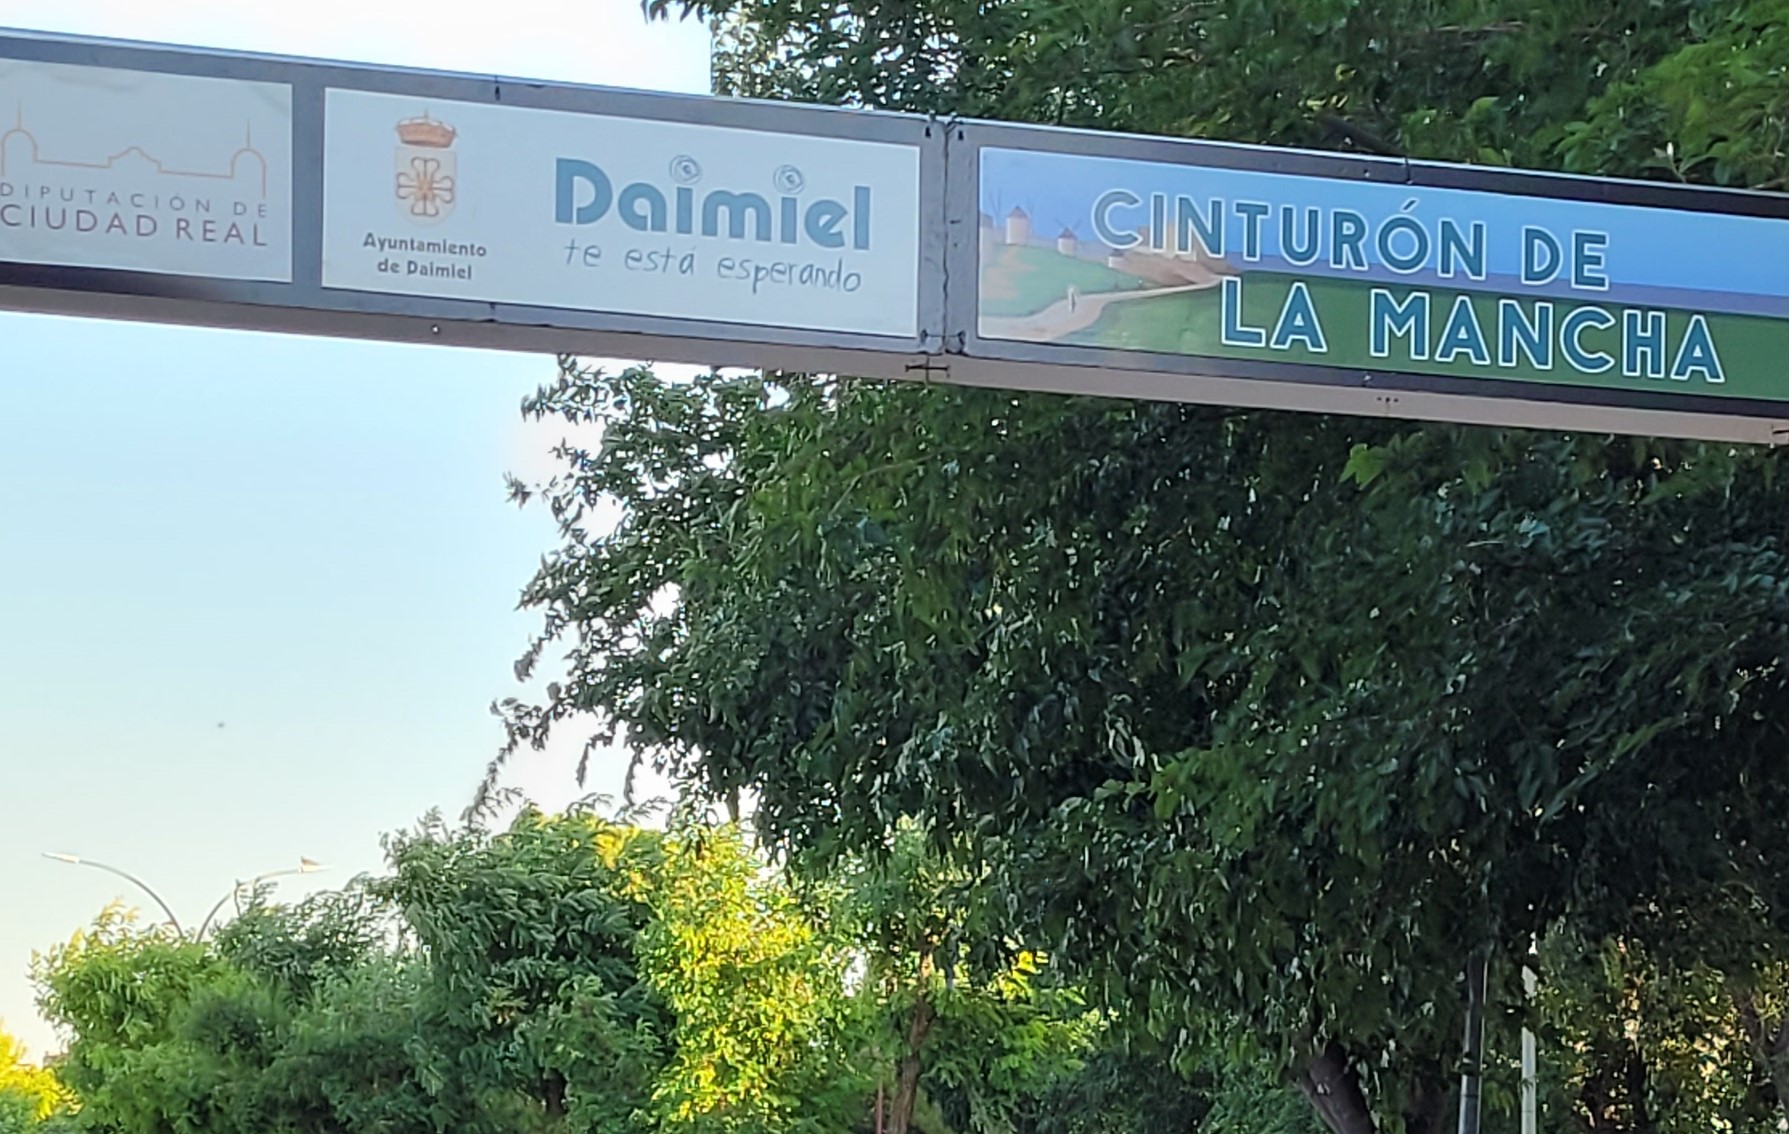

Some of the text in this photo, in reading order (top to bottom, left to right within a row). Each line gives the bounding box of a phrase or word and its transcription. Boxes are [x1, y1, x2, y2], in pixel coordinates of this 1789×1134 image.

[0, 204, 268, 246] CIUDAD REAL
[234, 201, 267, 218] DE
[554, 155, 871, 250] Daimiel
[363, 232, 487, 257] Ayuntamiento
[1091, 189, 1611, 290] CINTURÓN DE
[377, 257, 472, 280] de Daimiel
[565, 240, 862, 295] te está esperando
[1220, 275, 1726, 384] LA MANCHA
